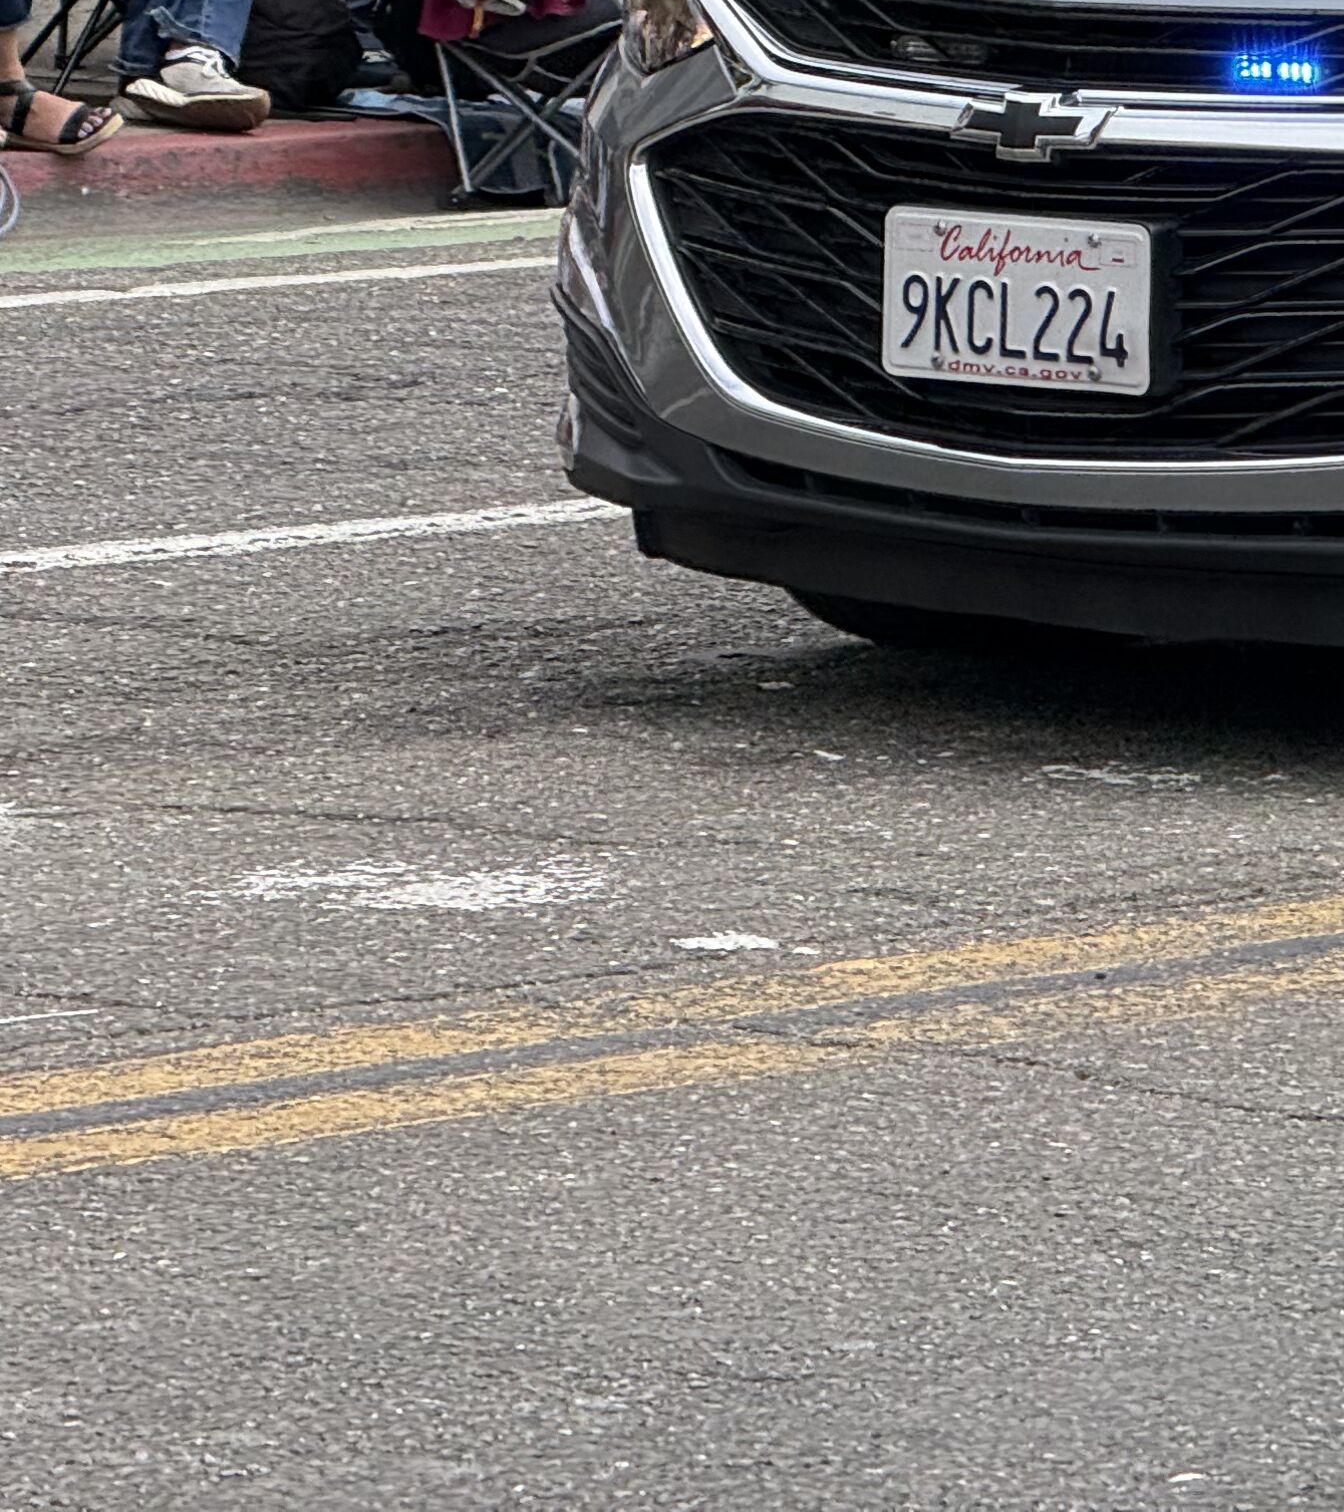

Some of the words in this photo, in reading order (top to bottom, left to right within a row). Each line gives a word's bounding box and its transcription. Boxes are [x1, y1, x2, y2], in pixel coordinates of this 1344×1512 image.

[939, 224, 1101, 277] California
[900, 274, 1129, 368] 9KCL224
[948, 359, 1082, 381] dmv.ca.gov
